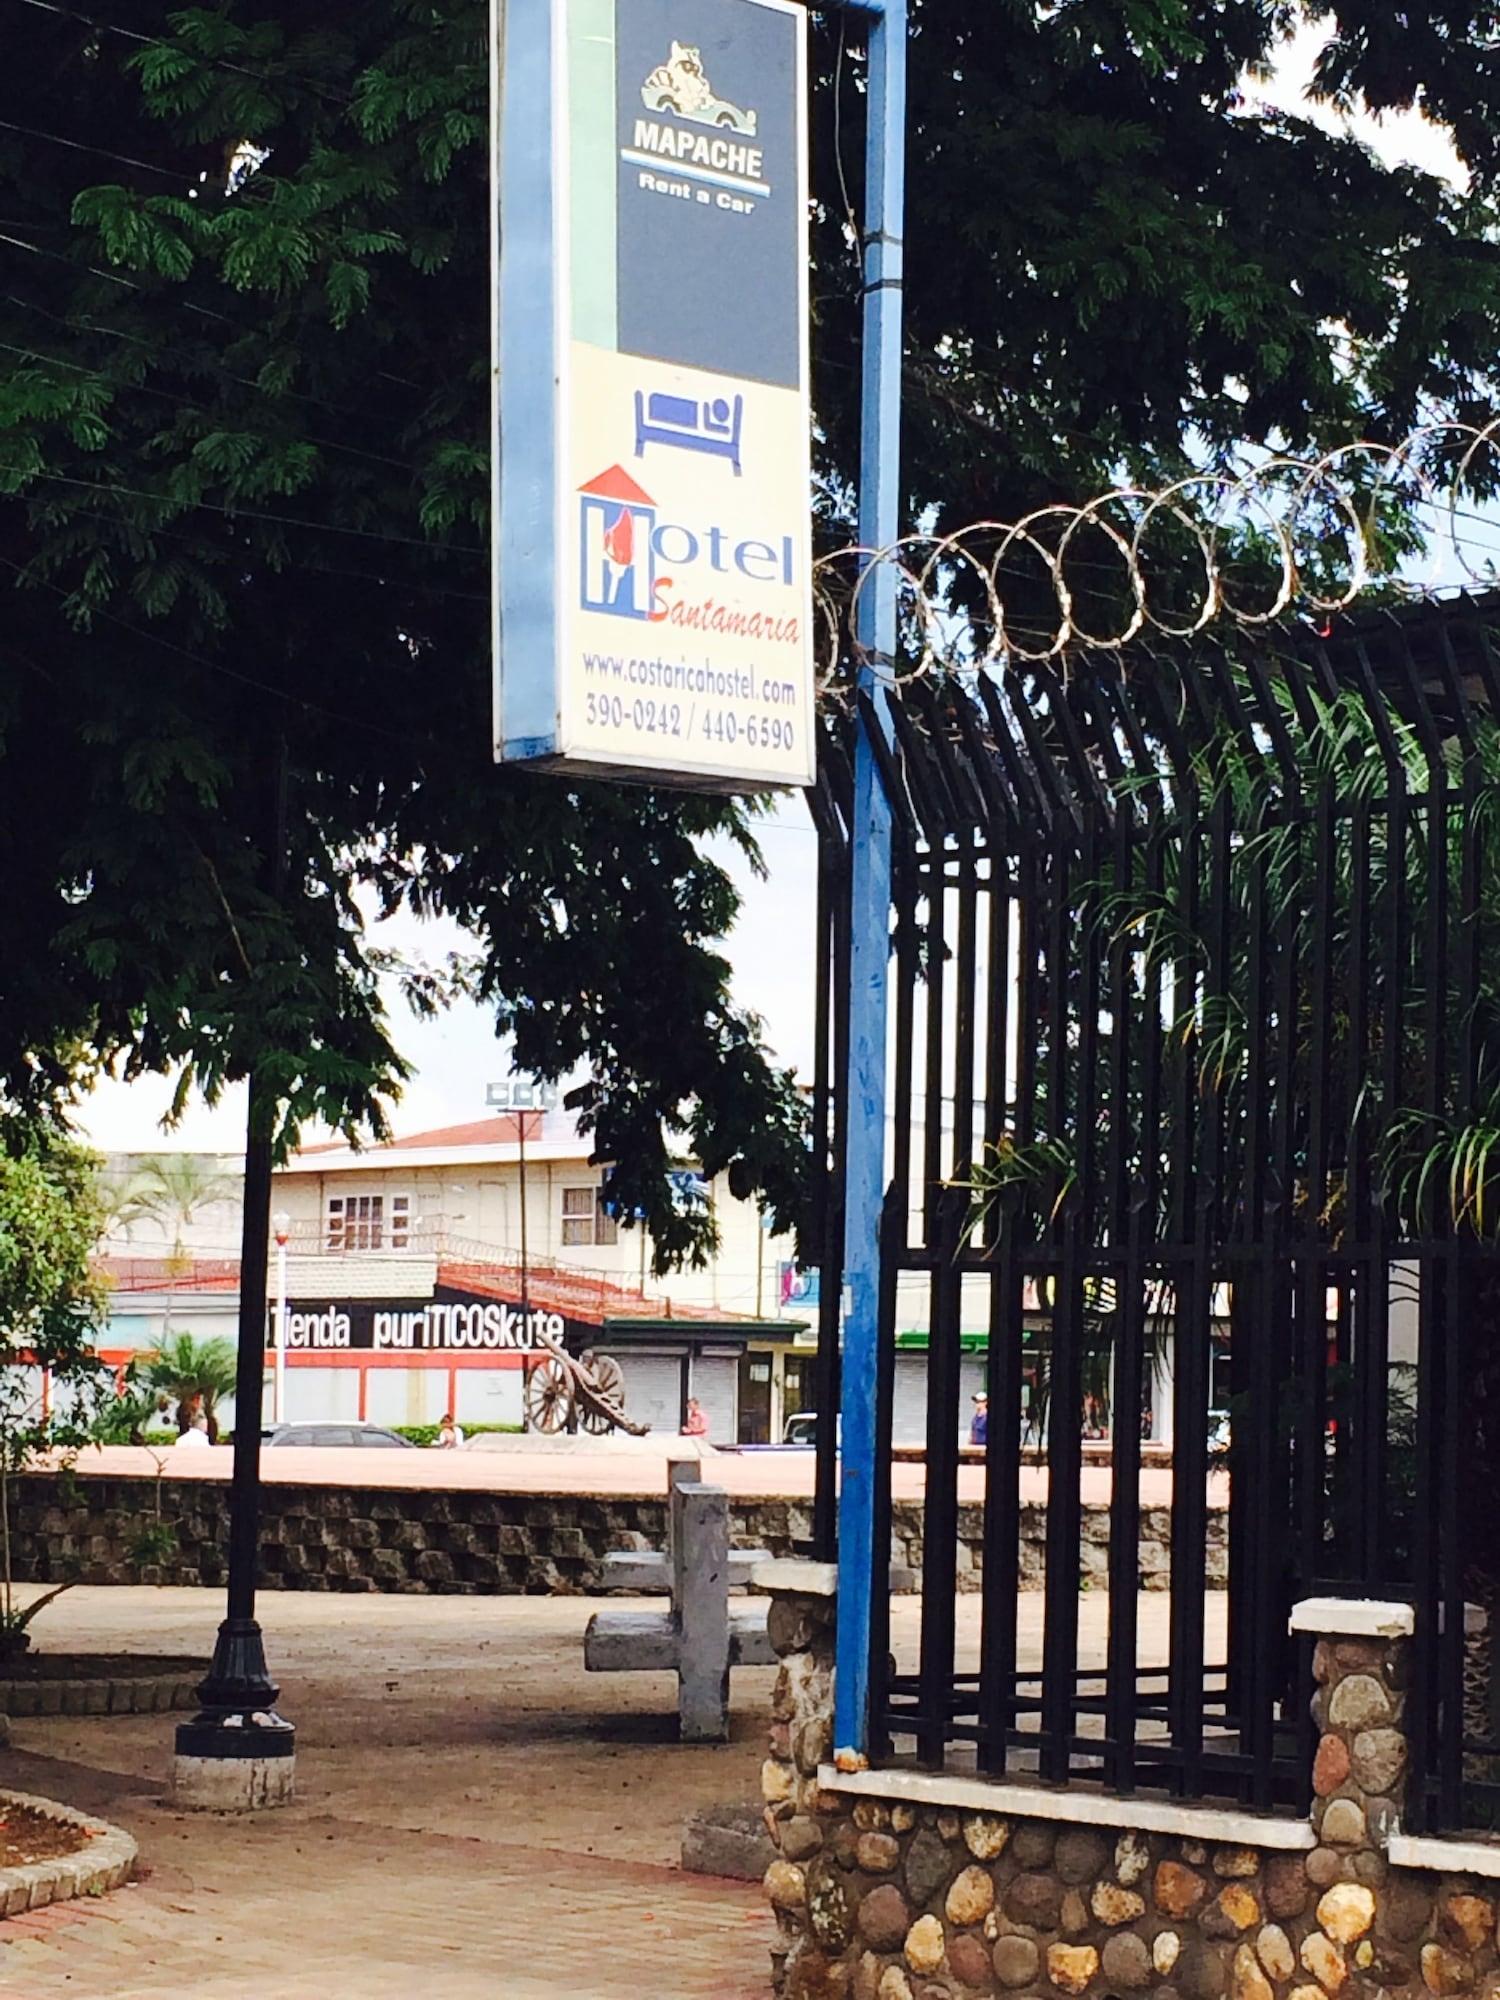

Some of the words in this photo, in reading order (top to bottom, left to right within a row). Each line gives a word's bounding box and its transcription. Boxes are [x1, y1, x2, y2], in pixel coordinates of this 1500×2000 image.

[634, 120, 762, 178] MAPACHE
[639, 172, 690, 199] Rent
[696, 189, 710, 204] a
[716, 192, 755, 214] Car
[646, 577, 800, 644] Santamaria
[583, 652, 796, 706] www.costaricahostel.com
[587, 692, 680, 737] 390-0242
[702, 709, 794, 751] 440-6590
